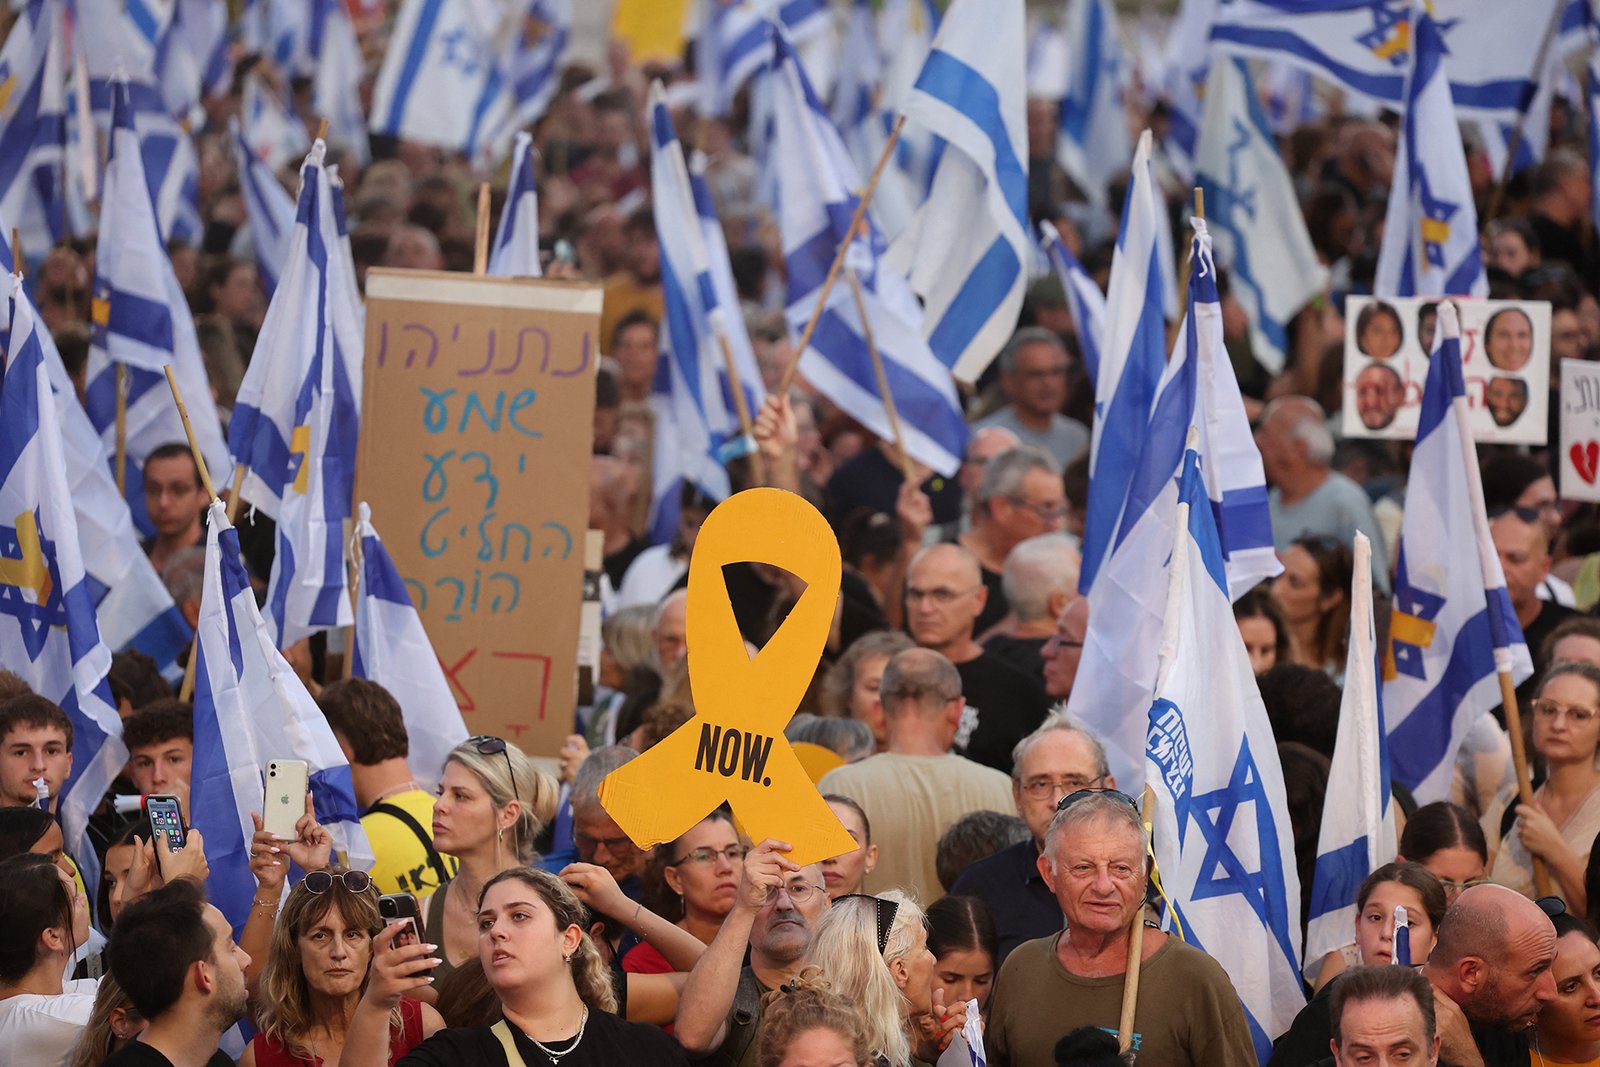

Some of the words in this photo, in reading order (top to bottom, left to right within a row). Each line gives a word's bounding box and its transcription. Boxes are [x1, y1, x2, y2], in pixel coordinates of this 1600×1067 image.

[378, 321, 591, 376] נתניהו
[419, 386, 544, 438] שמע
[422, 450, 526, 509] ידע
[419, 507, 573, 562] החליט
[694, 722, 774, 787] NOW.
